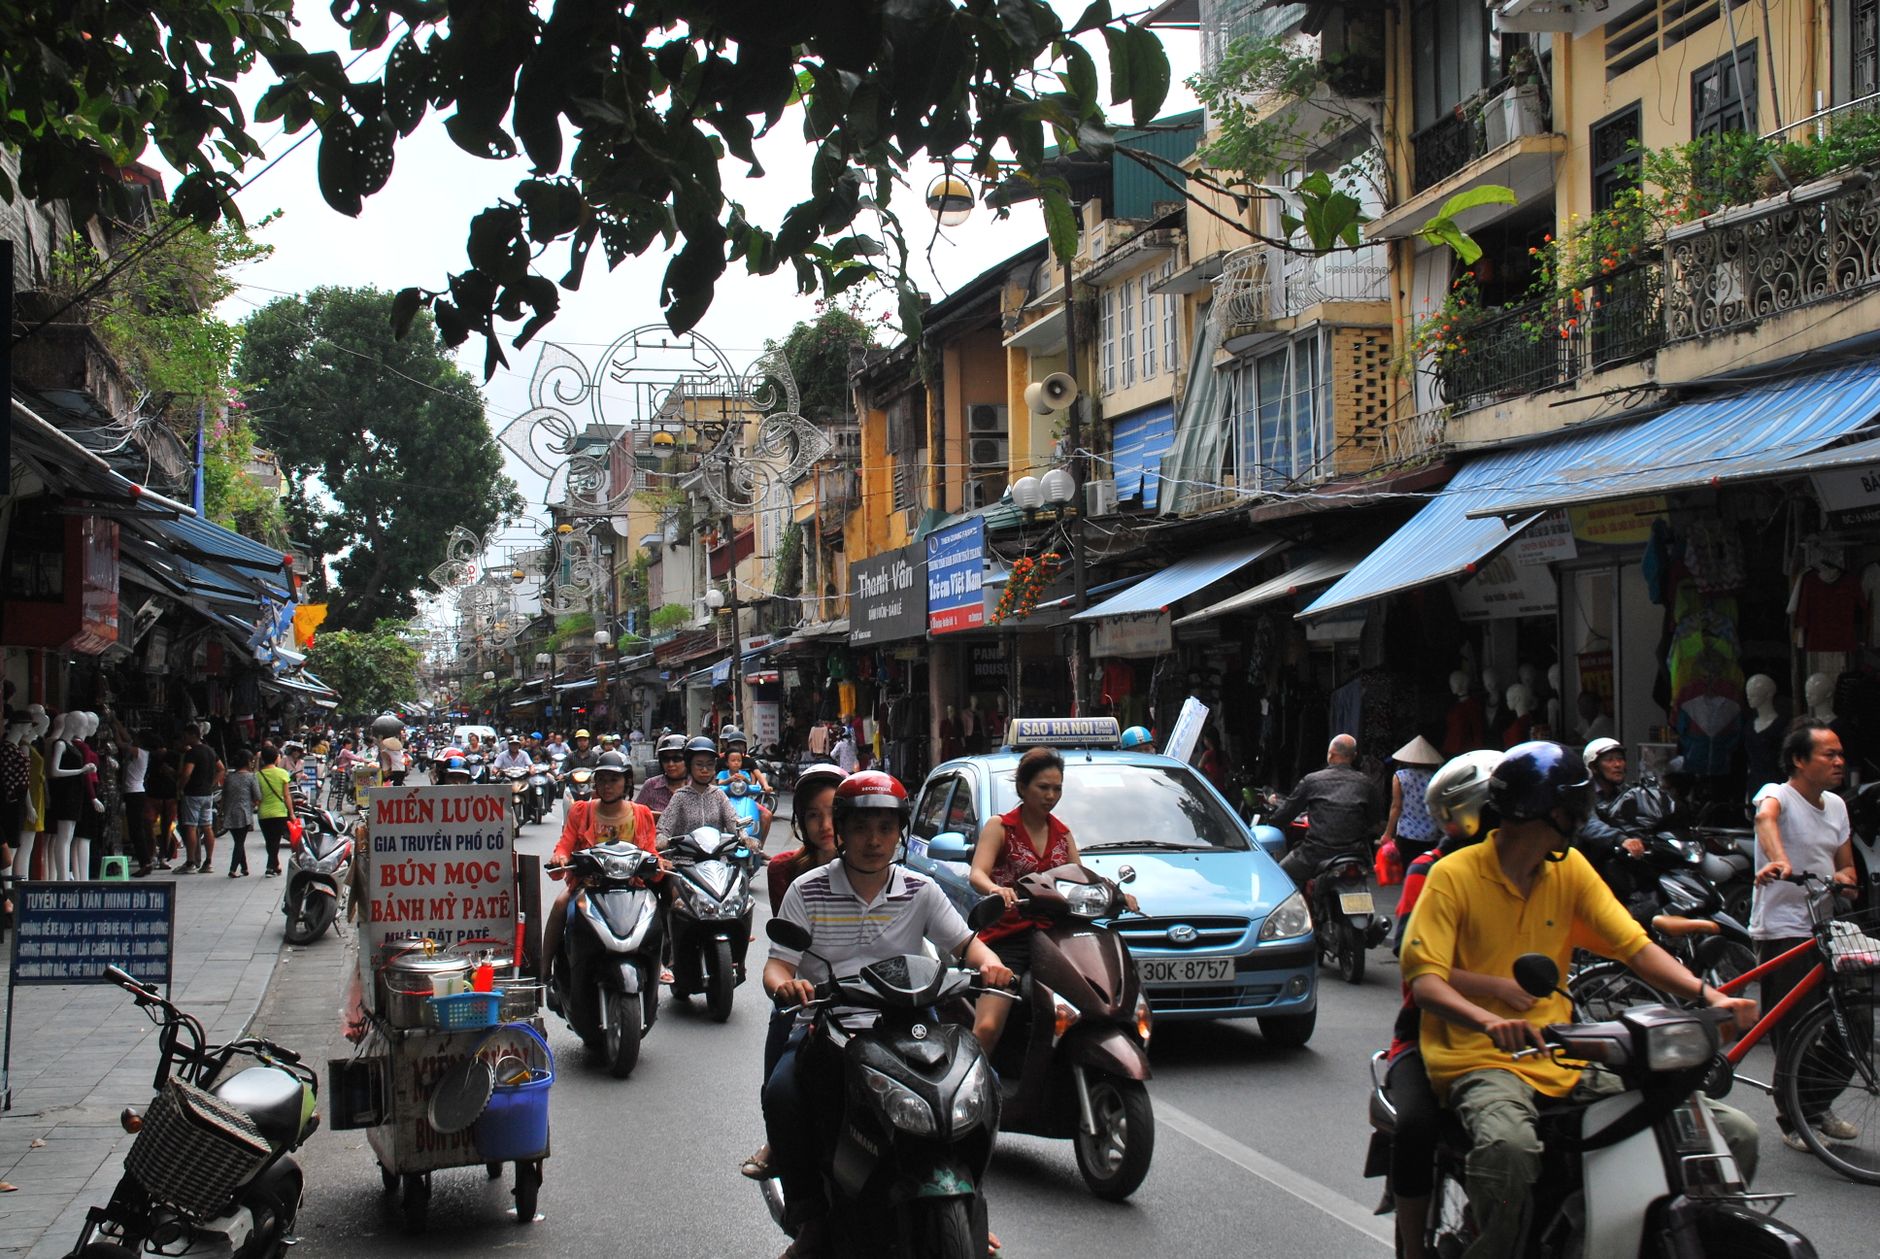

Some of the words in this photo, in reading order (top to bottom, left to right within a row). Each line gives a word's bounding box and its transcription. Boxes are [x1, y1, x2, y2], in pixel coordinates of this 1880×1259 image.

[1861, 470, 1880, 493] BÁ
[858, 566, 889, 599] Thanh
[892, 559, 913, 591] Vân
[1022, 721, 1048, 735] SAO
[376, 788, 435, 824] MIẾN
[441, 794, 505, 823] LƯƠN
[374, 836, 397, 852] GIA
[401, 829, 452, 851] TRUYỀN
[456, 828, 482, 850] PHỐ
[487, 827, 504, 850] CỔ
[380, 858, 437, 887] BÚN
[444, 861, 500, 889] MỌC
[27, 888, 57, 909] TUYẾN
[104, 893, 131, 909] MINH
[370, 892, 425, 922] BÁNH
[462, 889, 511, 919] PATÊ
[457, 926, 490, 942] PATÊ
[849, 1124, 879, 1157] YAMAHA
